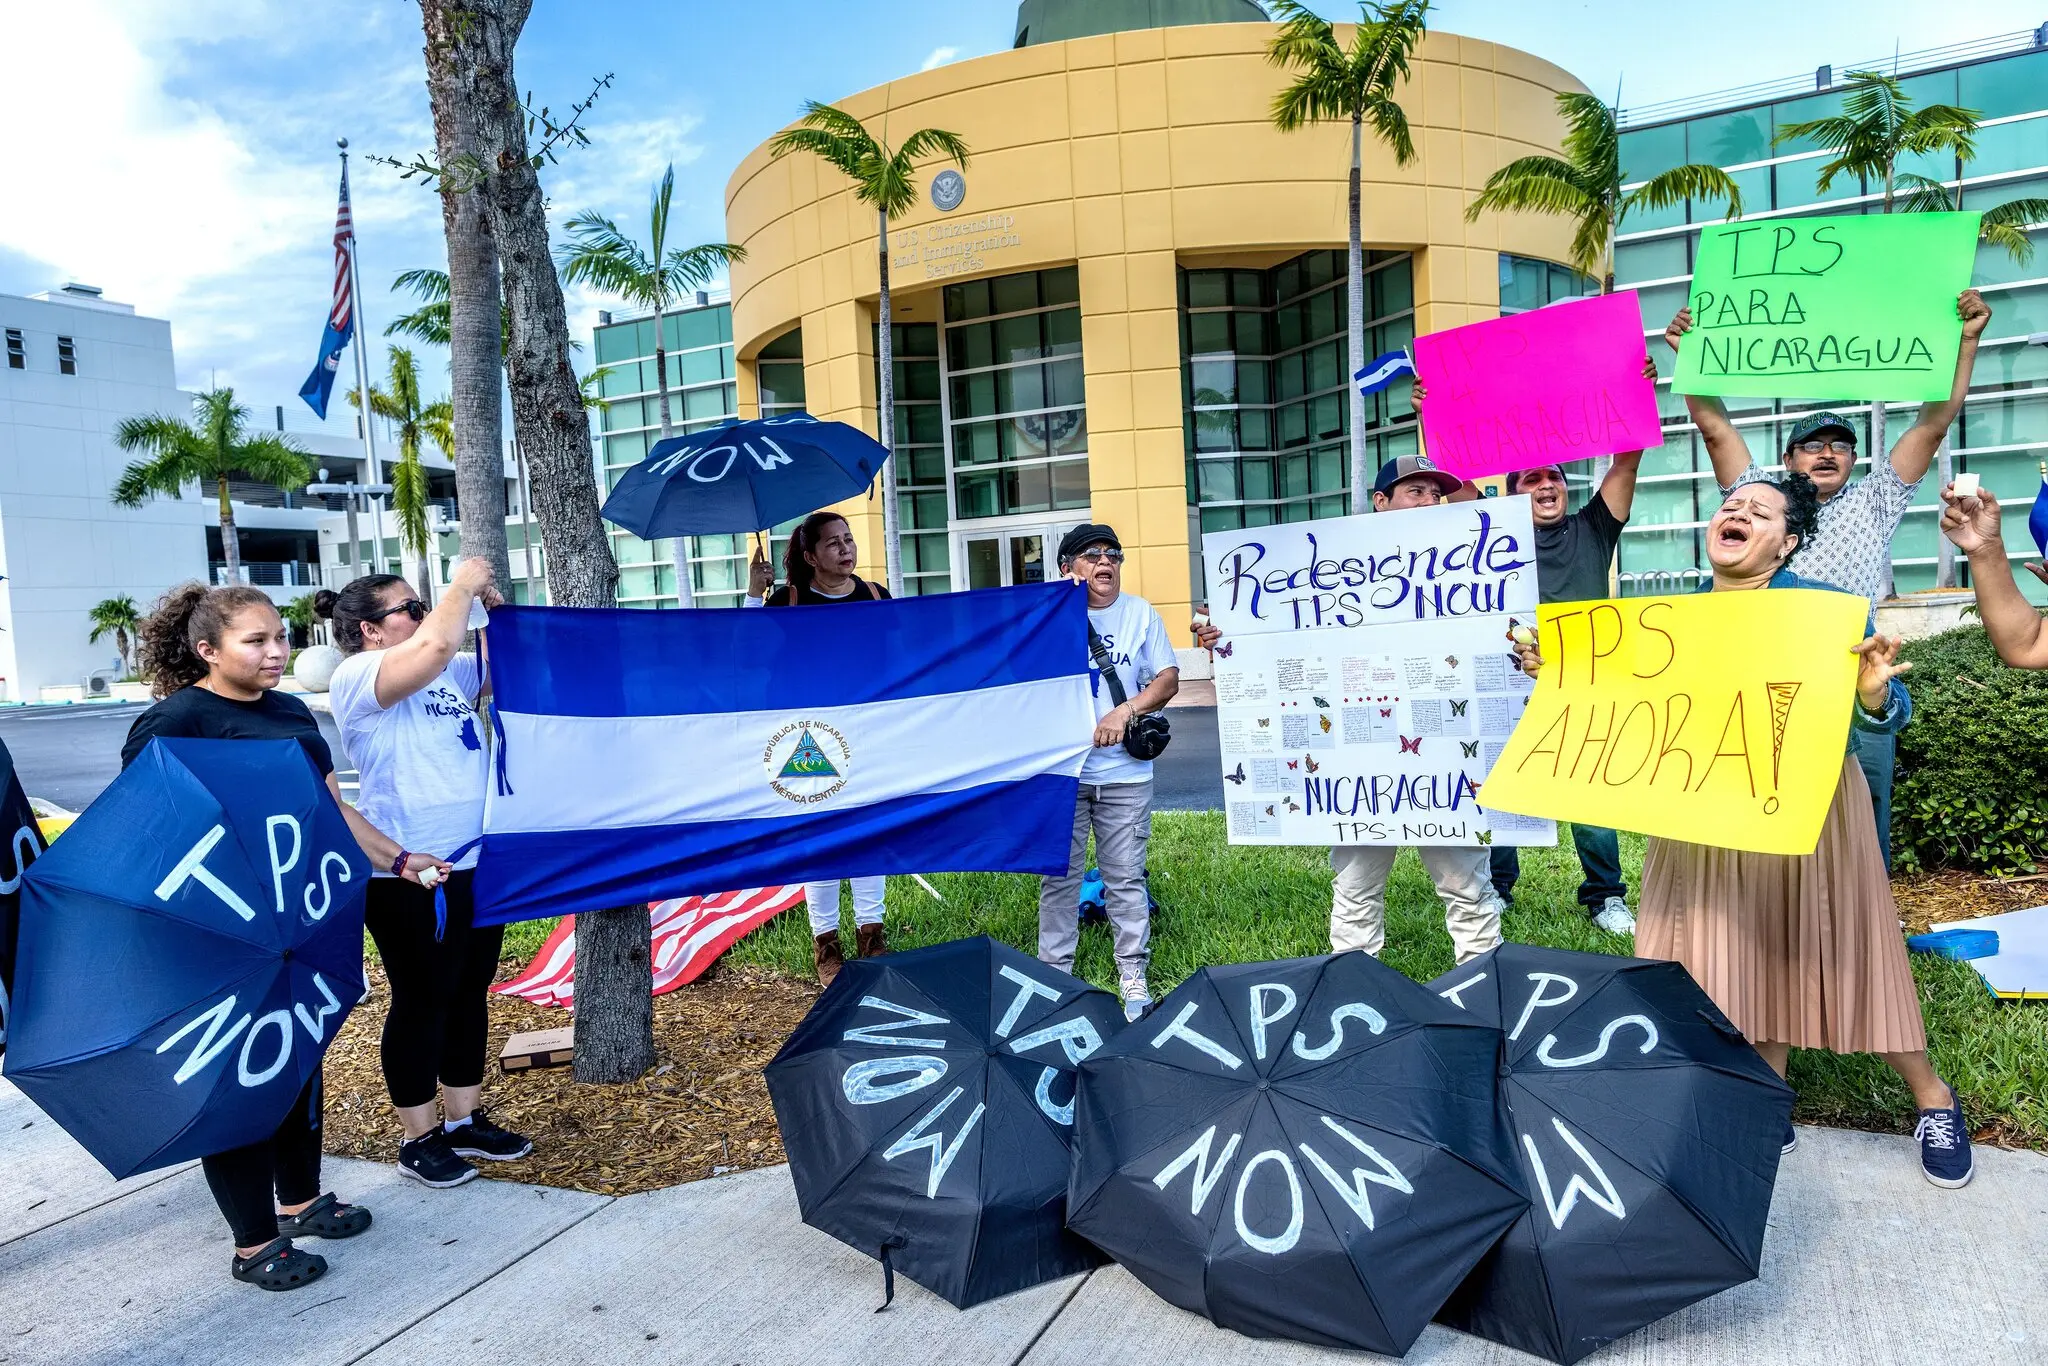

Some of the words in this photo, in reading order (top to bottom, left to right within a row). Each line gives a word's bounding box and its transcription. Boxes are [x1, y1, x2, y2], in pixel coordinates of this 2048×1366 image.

[893, 249, 919, 268] and
[923, 232, 1020, 262] Immigration
[896, 230, 922, 249] U.S.
[927, 214, 1014, 241] Citizenship
[1717, 225, 1844, 276] TPS
[926, 257, 984, 278] Services
[1695, 289, 1806, 327] PARA
[1700, 332, 1933, 372] NICARAGUA
[1450, 382, 1478, 407] 4
[1434, 386, 1632, 468] NICARAGUA
[648, 436, 793, 482] NOW
[1218, 509, 1537, 620] Redesignate
[1415, 571, 1519, 619] NOW
[1546, 603, 1676, 689] TPS
[763, 723, 797, 763] REPÚBLICA
[799, 720, 811, 729] DE
[813, 721, 851, 760] NICARAGUA
[1516, 682, 1803, 816] AHORA!
[808, 779, 847, 803] CENTRAL
[1304, 770, 1482, 816] NICARAGUA
[154, 813, 351, 921] TPS
[155, 972, 341, 1087] NOW
[1151, 983, 1388, 1070] TPS
[1438, 972, 1658, 1068] TPS
[842, 995, 986, 1199] NOW
[1152, 1115, 1414, 1256] NOW
